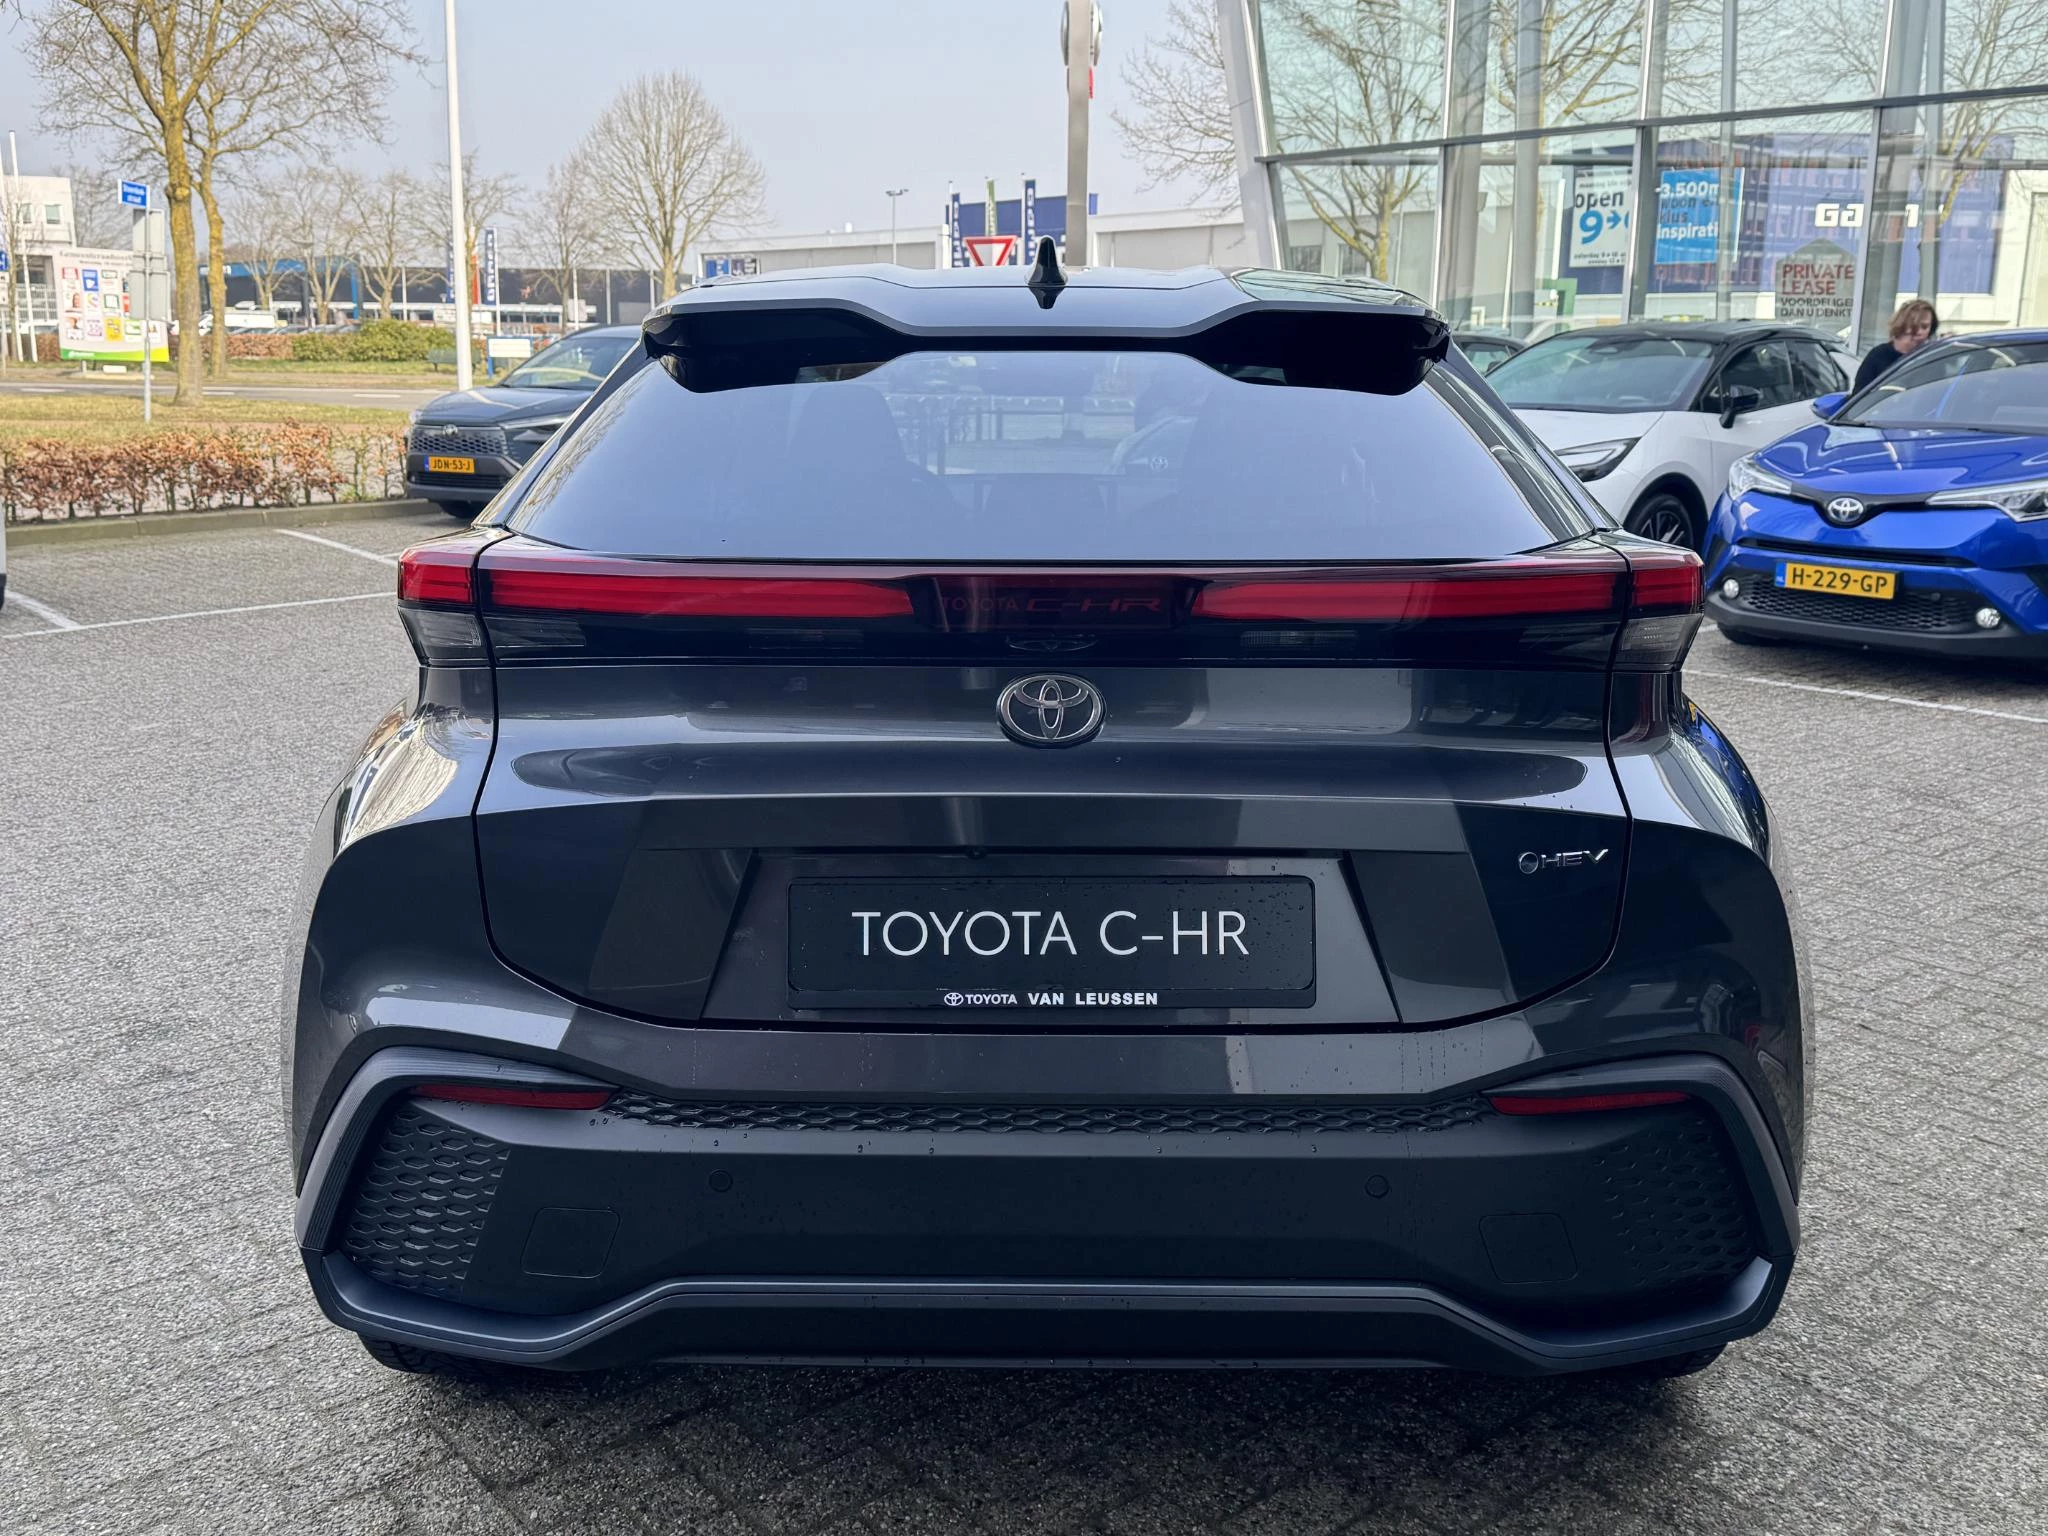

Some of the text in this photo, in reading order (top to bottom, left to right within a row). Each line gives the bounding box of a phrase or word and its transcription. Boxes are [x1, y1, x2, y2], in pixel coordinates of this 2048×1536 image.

[1575, 191, 1624, 213] open
[1656, 221, 1719, 241] inspirati
[1782, 264, 1854, 279] PRIVATE
[1782, 280, 1836, 295] LEASE
[1780, 297, 1853, 307] VOORDELIGE
[1792, 567, 1888, 593] H-229-GP
[942, 598, 1019, 612] TOYOTA
[852, 910, 1250, 956] TOYOTA C-HR
[965, 992, 1158, 1005] TOYOTA VAN LEUSSEN
